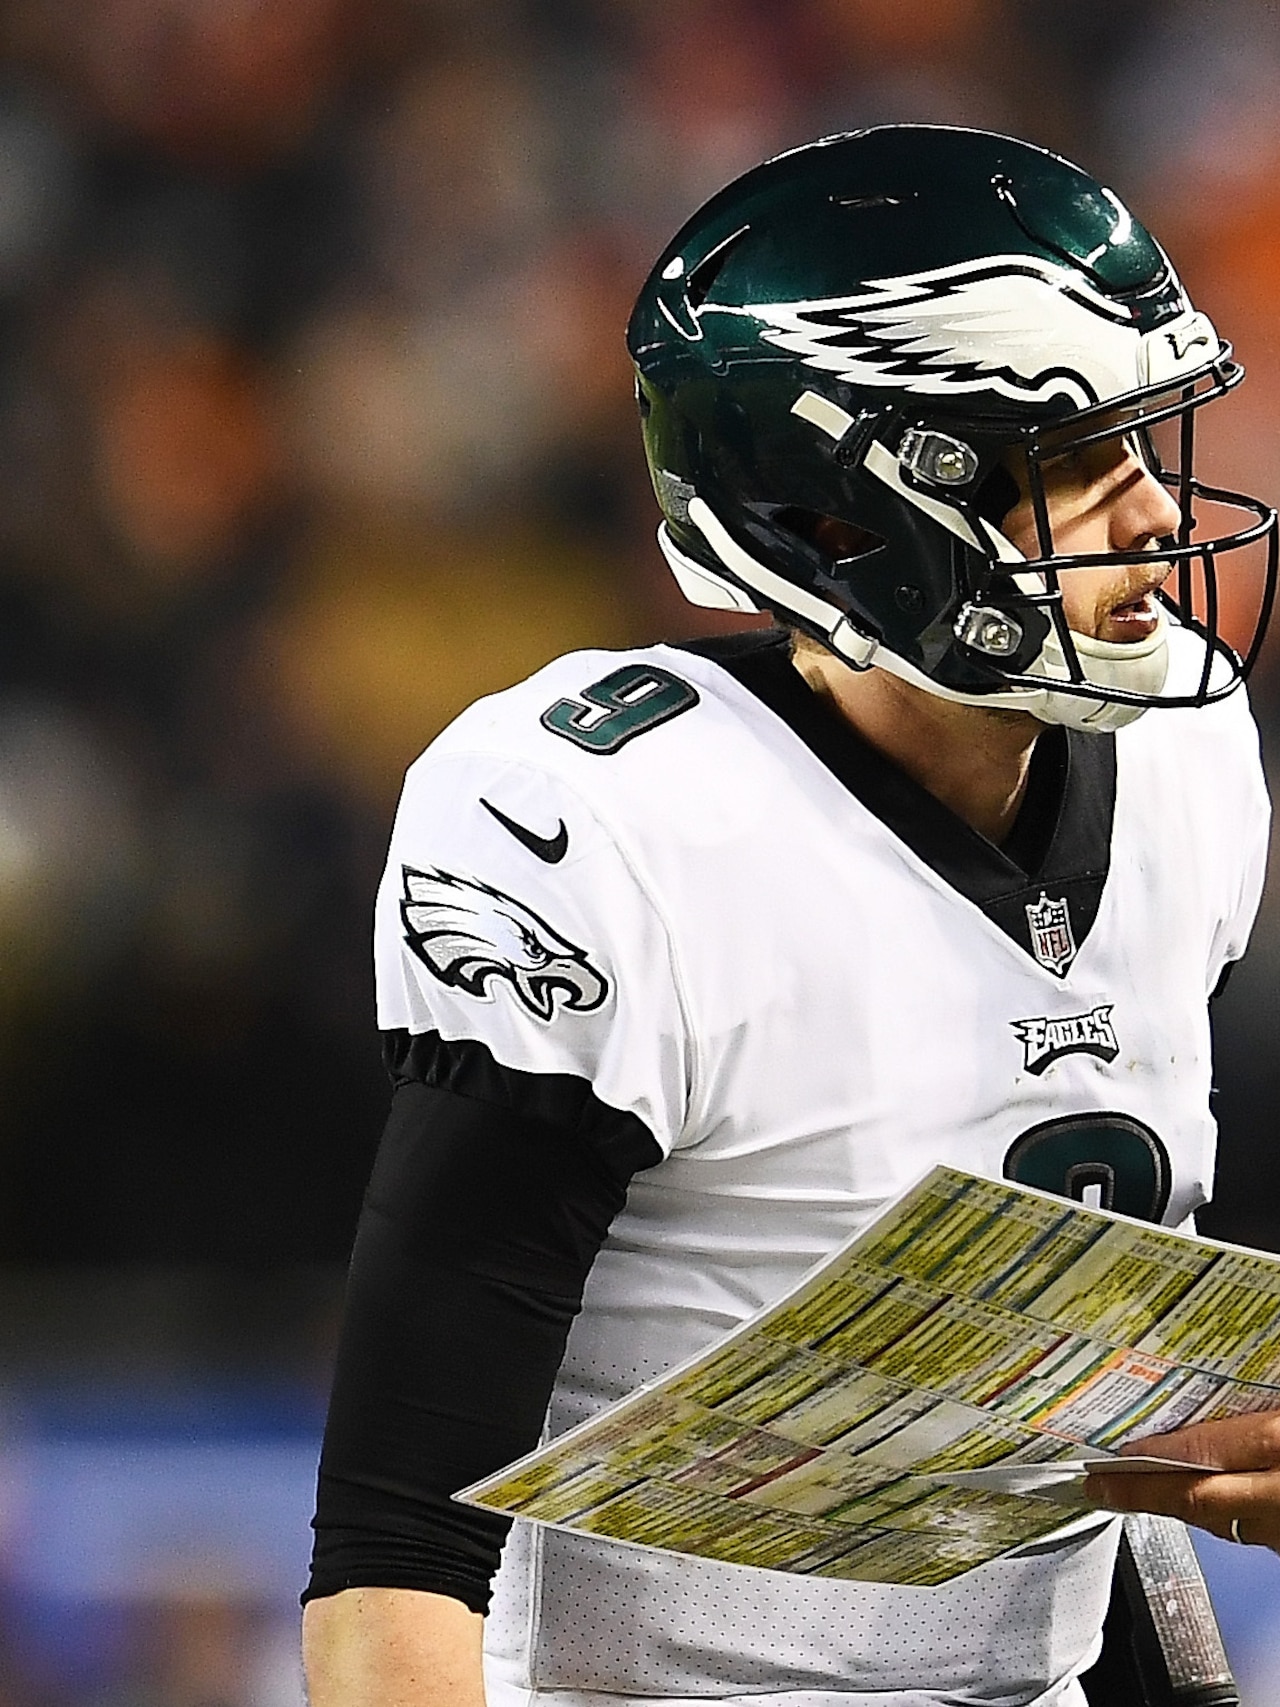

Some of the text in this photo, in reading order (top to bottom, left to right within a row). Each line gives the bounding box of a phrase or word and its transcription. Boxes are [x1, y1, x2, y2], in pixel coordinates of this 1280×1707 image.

[539, 663, 701, 756] 9
[1037, 928, 1069, 960] NFL
[1008, 1004, 1119, 1077] EAGLES
